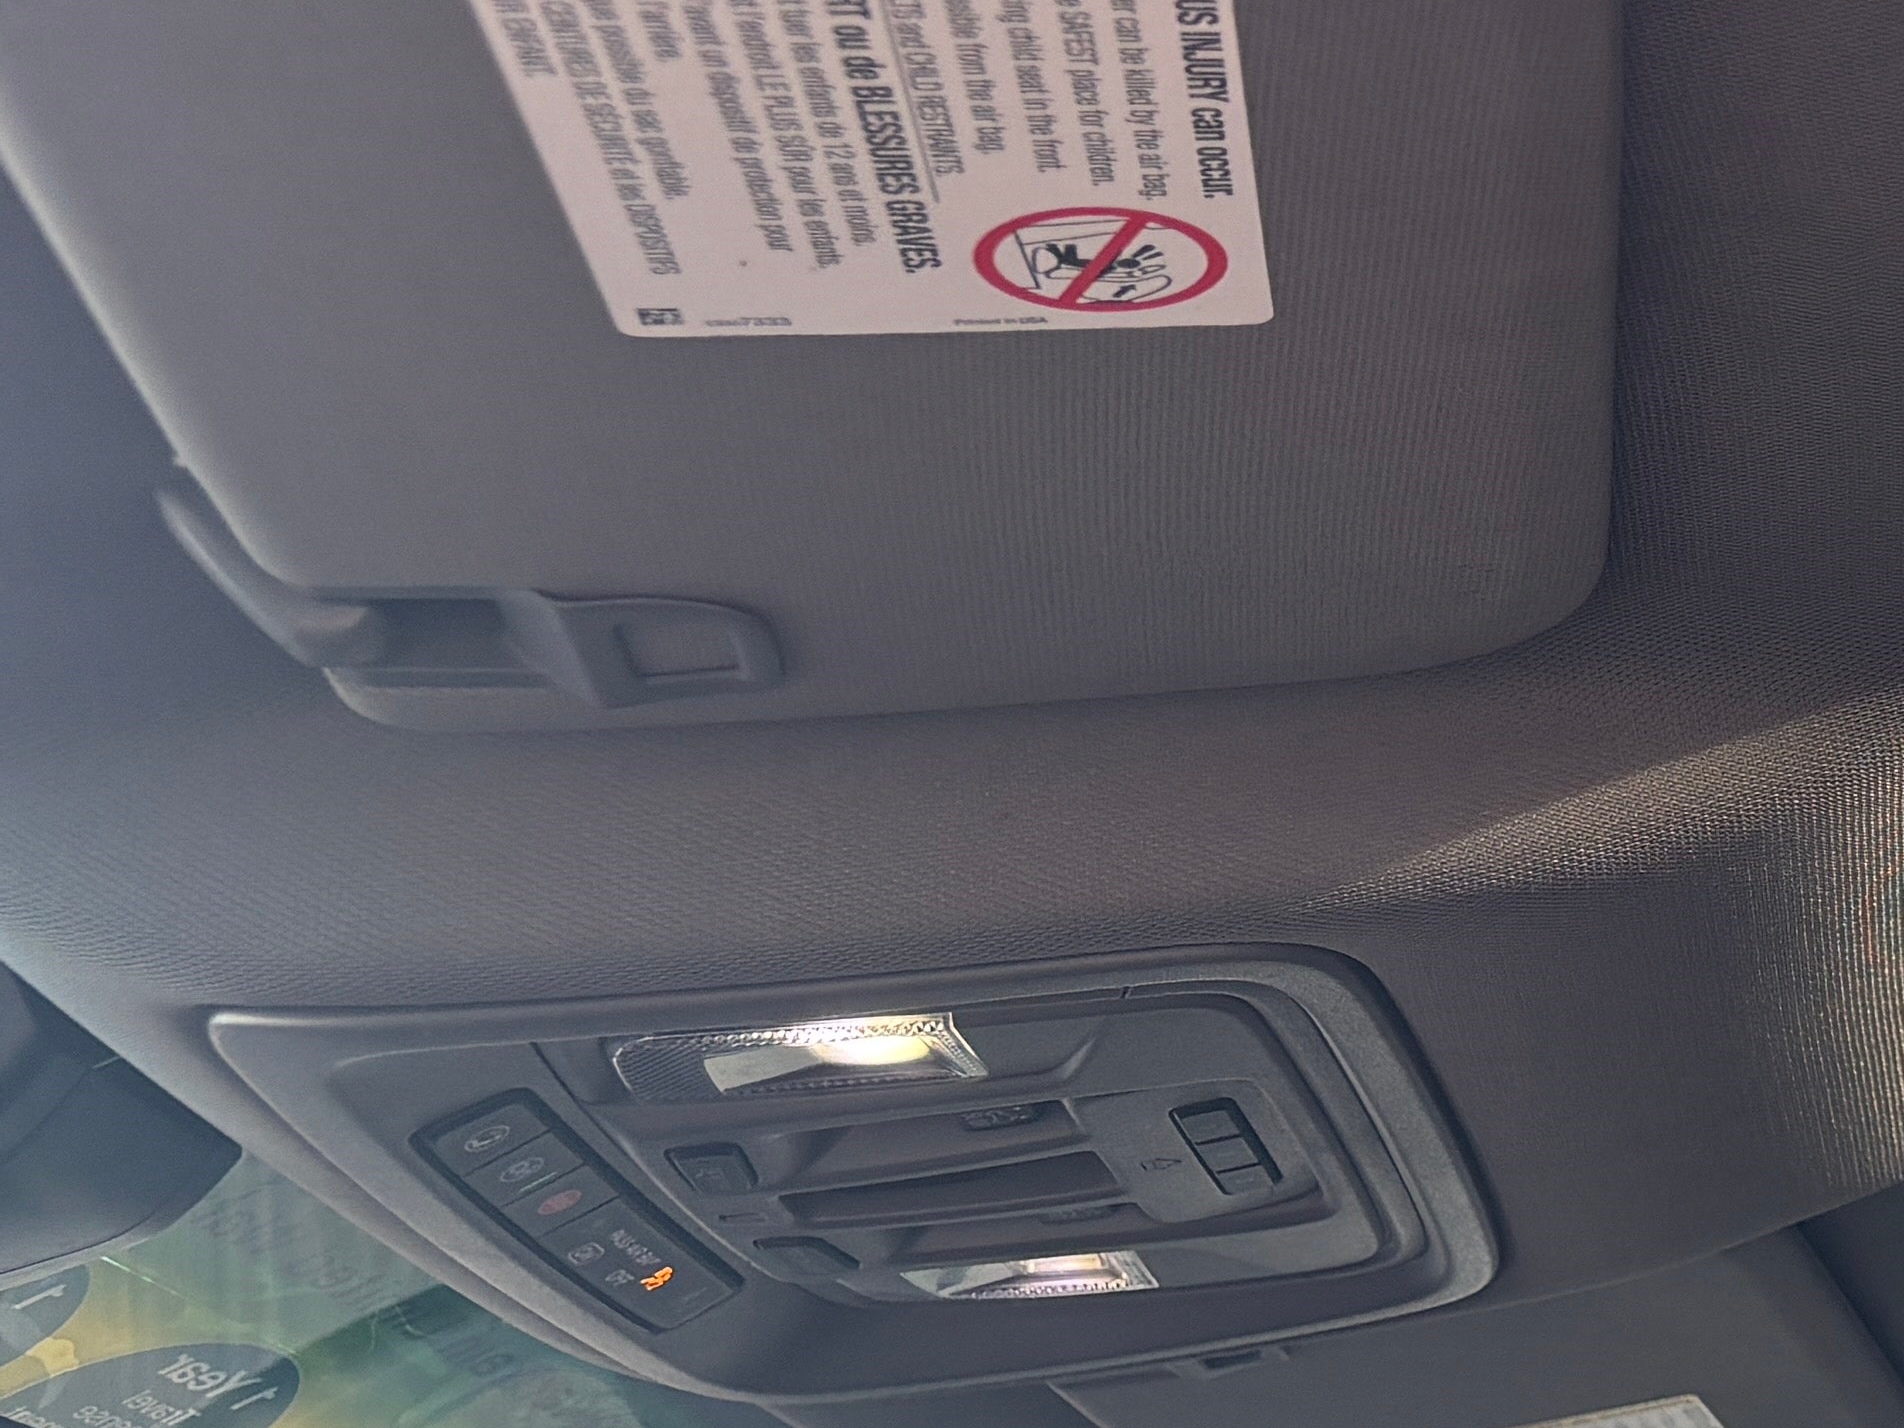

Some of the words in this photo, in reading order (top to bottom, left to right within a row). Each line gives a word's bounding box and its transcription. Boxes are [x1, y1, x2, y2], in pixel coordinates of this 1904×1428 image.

[830, 23, 872, 51] ou
[1056, 9, 1101, 66] SAFEST
[1112, 15, 1143, 44] can
[839, 54, 887, 81] de
[1116, 46, 1150, 65] be
[1179, 30, 1230, 103] INJURY
[1062, 67, 1102, 106] place
[1122, 67, 1159, 106] killed
[1076, 108, 1110, 129] for
[1123, 108, 1160, 126] by
[1189, 106, 1226, 142] can
[848, 84, 921, 196] BLESSURES
[1131, 128, 1164, 151] the
[1080, 130, 1118, 187] children.
[1136, 151, 1169, 171] air
[1195, 145, 1234, 199] occur.
[1136, 172, 1171, 201] bag.
[883, 198, 943, 274] GRAVES.
